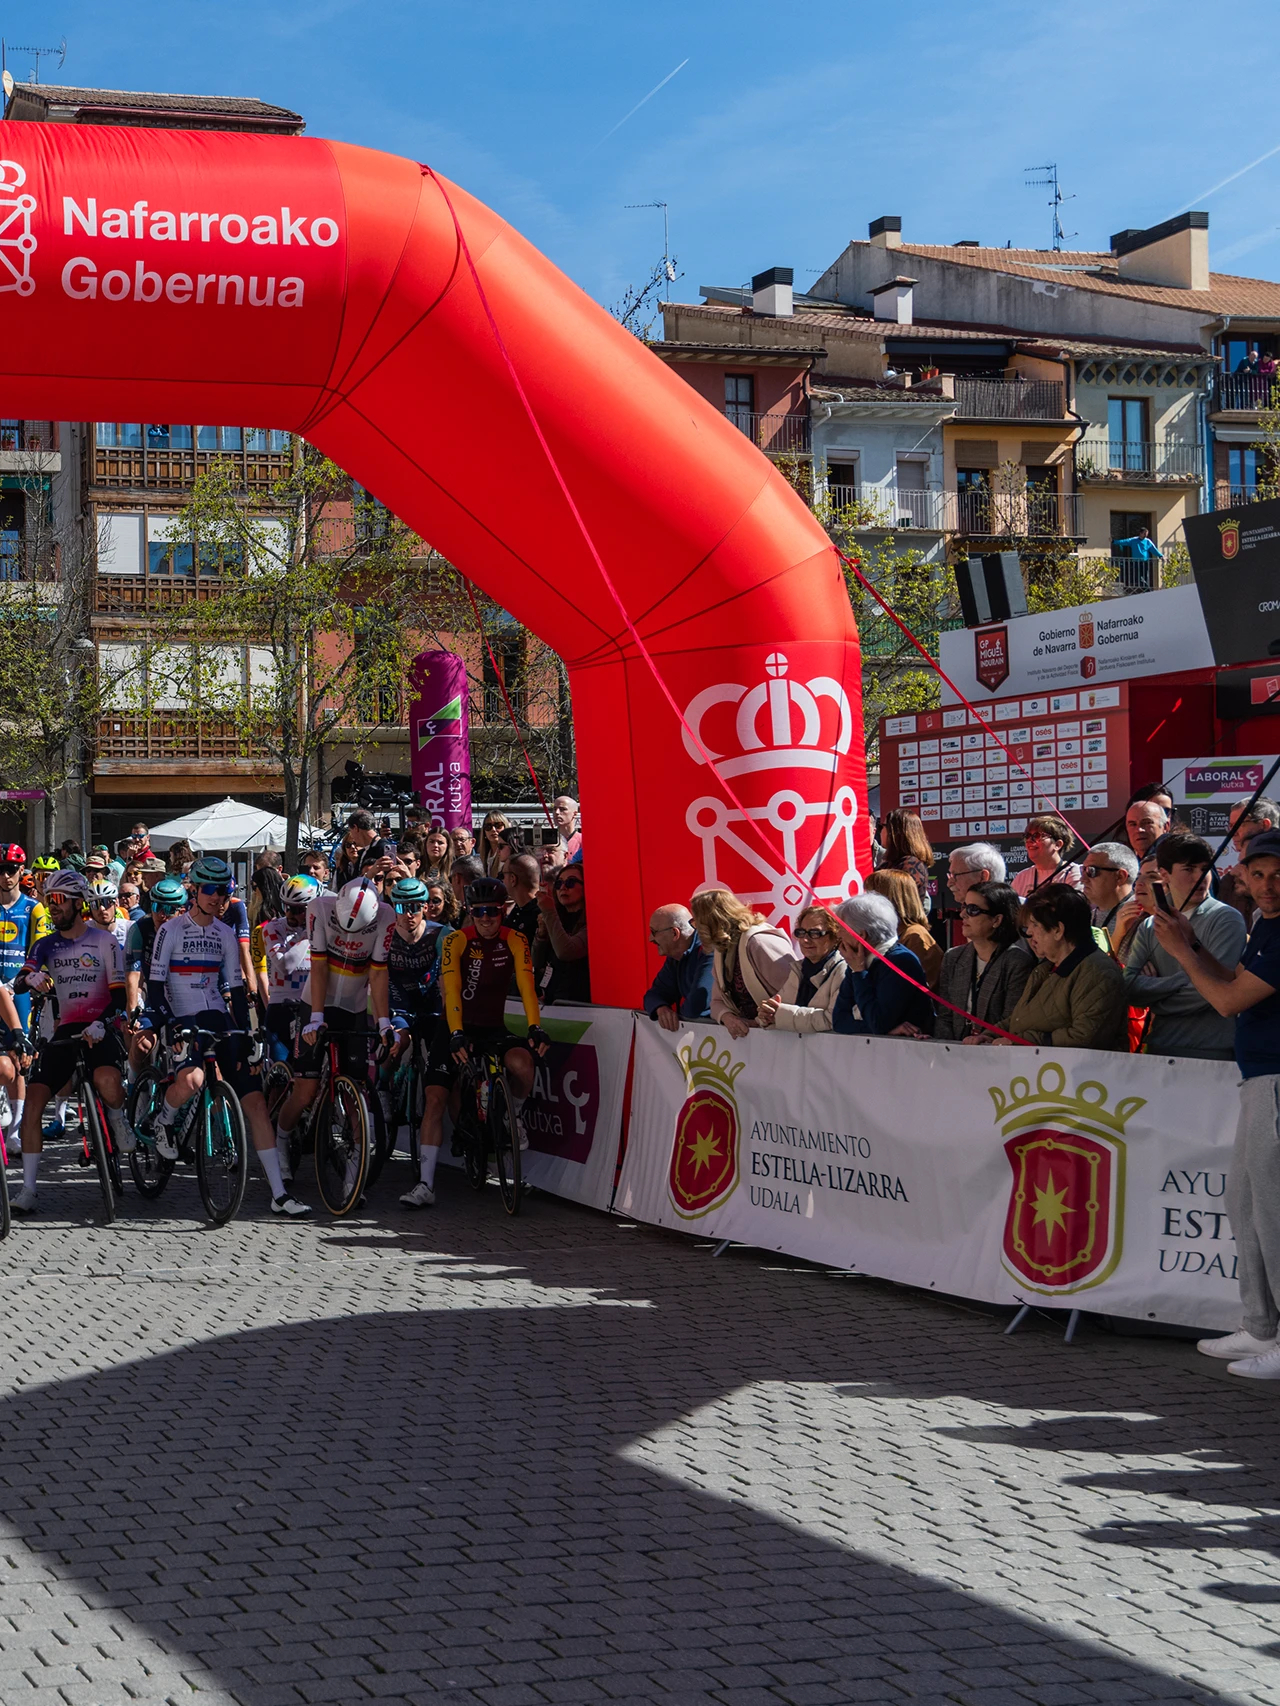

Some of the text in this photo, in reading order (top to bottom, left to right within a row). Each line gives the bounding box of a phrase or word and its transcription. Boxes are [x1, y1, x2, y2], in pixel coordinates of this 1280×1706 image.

[62, 196, 340, 248] Nafarroako
[61, 256, 305, 309] Gobernua
[1039, 628, 1076, 641] Gobierno
[1097, 615, 1144, 631] Nafarroako
[980, 639, 989, 649] GP
[1033, 642, 1076, 656] de Navarra
[1097, 631, 1139, 645] Gobernua
[980, 647, 1003, 659] MIGUEL
[980, 657, 1004, 668] INDURAIN
[448, 762, 462, 813] kutxa
[1189, 771, 1244, 782] LABORAL
[1221, 781, 1244, 789] kutxa
[183, 940, 222, 950] BAHRAIN
[443, 933, 459, 966] Cofidis
[462, 958, 482, 1000] Cofidis
[521, 1106, 563, 1136] kutxa
[751, 1120, 871, 1159] AYUNTAMIENTO
[751, 1151, 910, 1203] ESTELLA-LIZARRA
[1159, 1170, 1227, 1197] AYU
[750, 1185, 801, 1215] UDALA
[1161, 1207, 1236, 1241] EST
